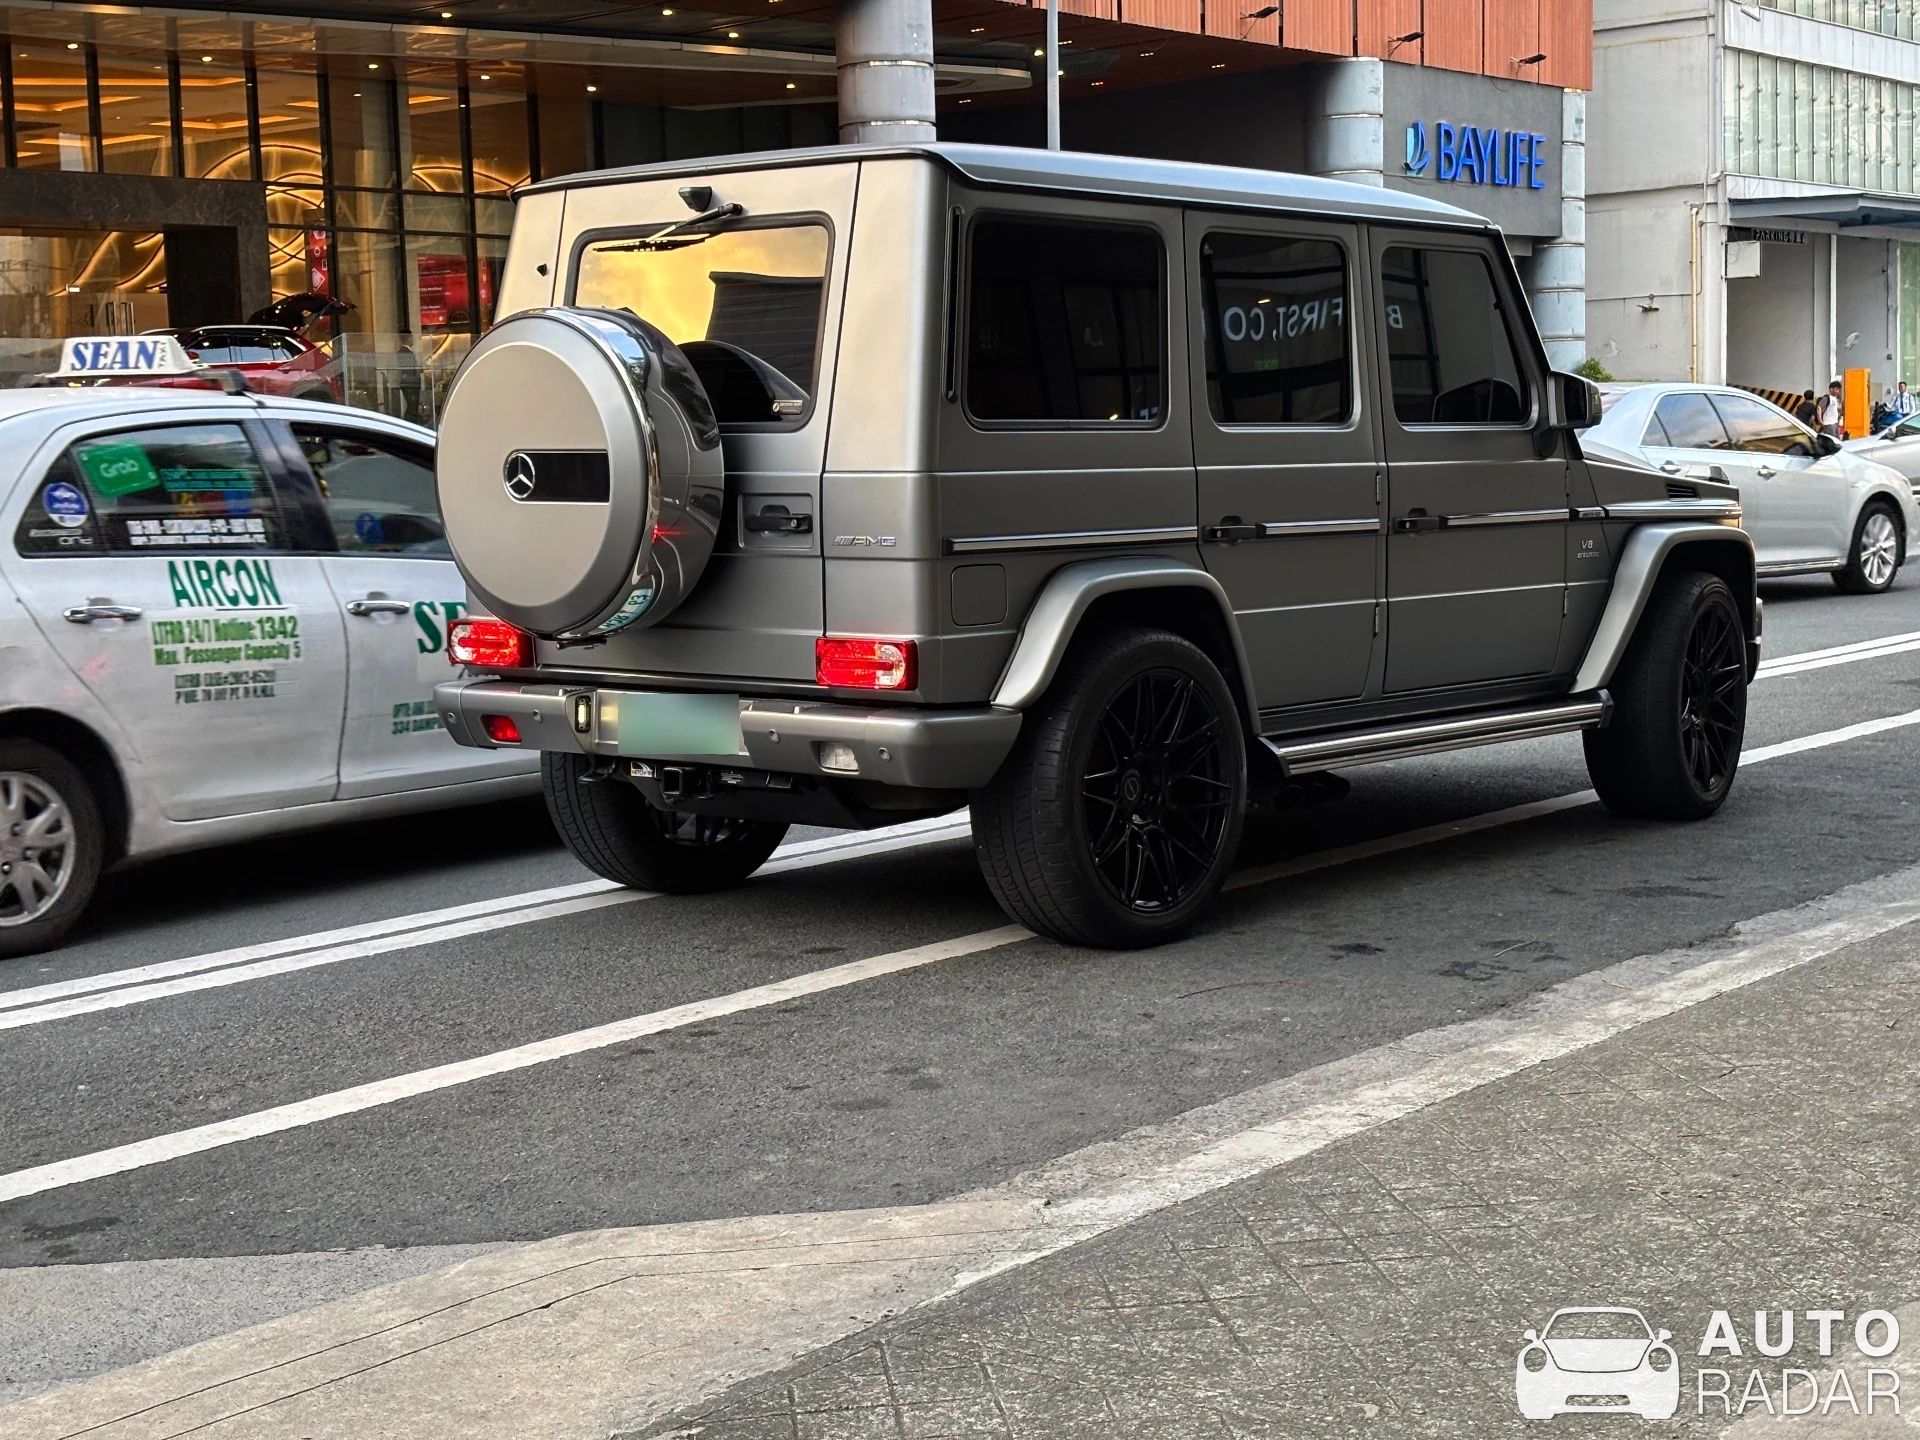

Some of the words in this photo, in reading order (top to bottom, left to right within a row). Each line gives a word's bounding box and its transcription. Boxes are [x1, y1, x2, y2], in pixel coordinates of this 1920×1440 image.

[1436, 121, 1546, 190] BAYLIFE
[1755, 230, 1790, 242] PARKING
[70, 341, 161, 371] SEAN
[100, 458, 139, 478] Grab
[851, 536, 897, 547] AMG
[1581, 539, 1594, 549] V8
[168, 559, 283, 608] AIRCON
[256, 615, 299, 640] 1342
